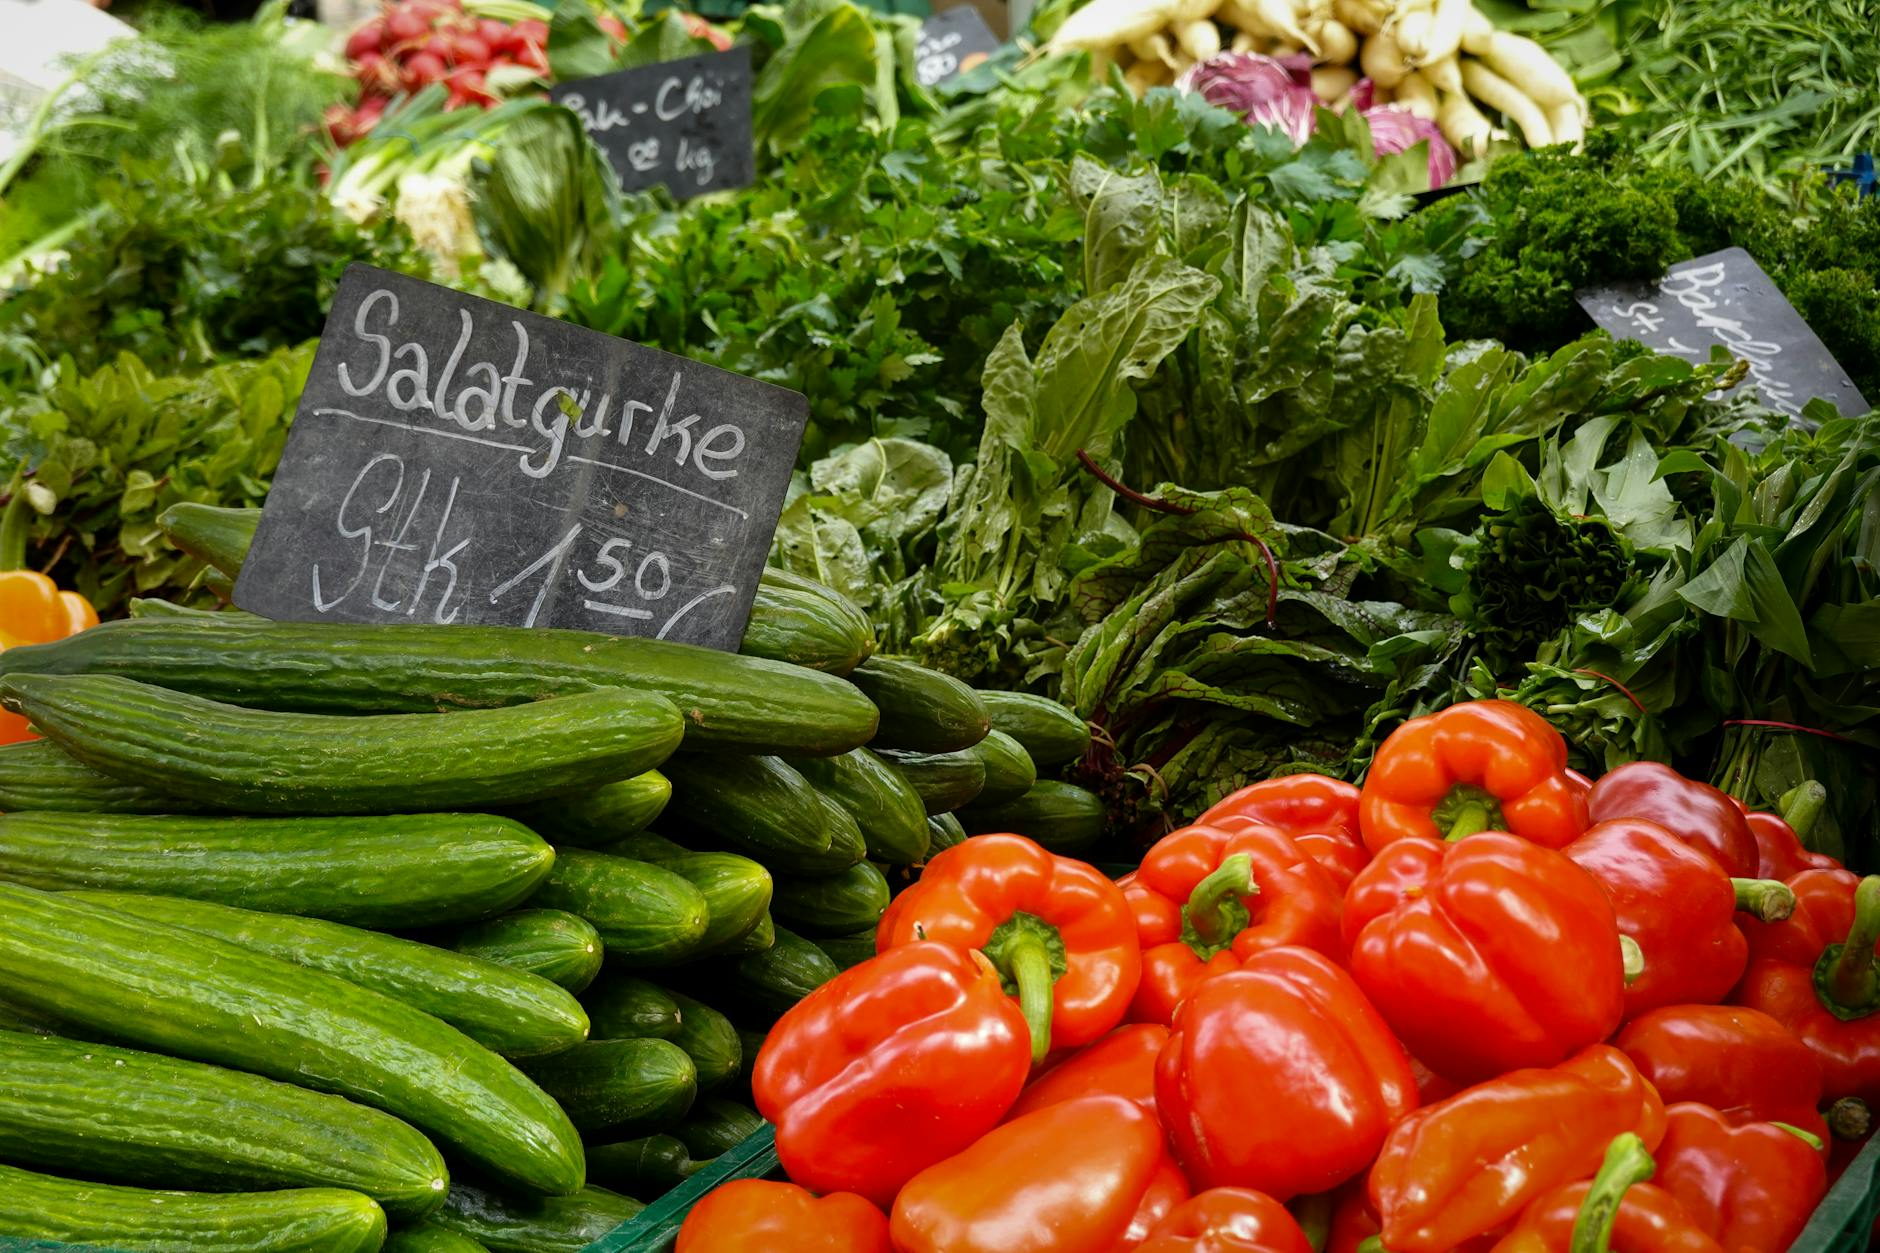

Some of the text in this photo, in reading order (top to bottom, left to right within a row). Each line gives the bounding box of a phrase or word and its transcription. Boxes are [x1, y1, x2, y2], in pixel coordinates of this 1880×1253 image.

[676, 137, 716, 186] kg
[1612, 302, 1664, 334] St.
[337, 288, 746, 480] Salatgurke
[312, 452, 471, 625] Stk
